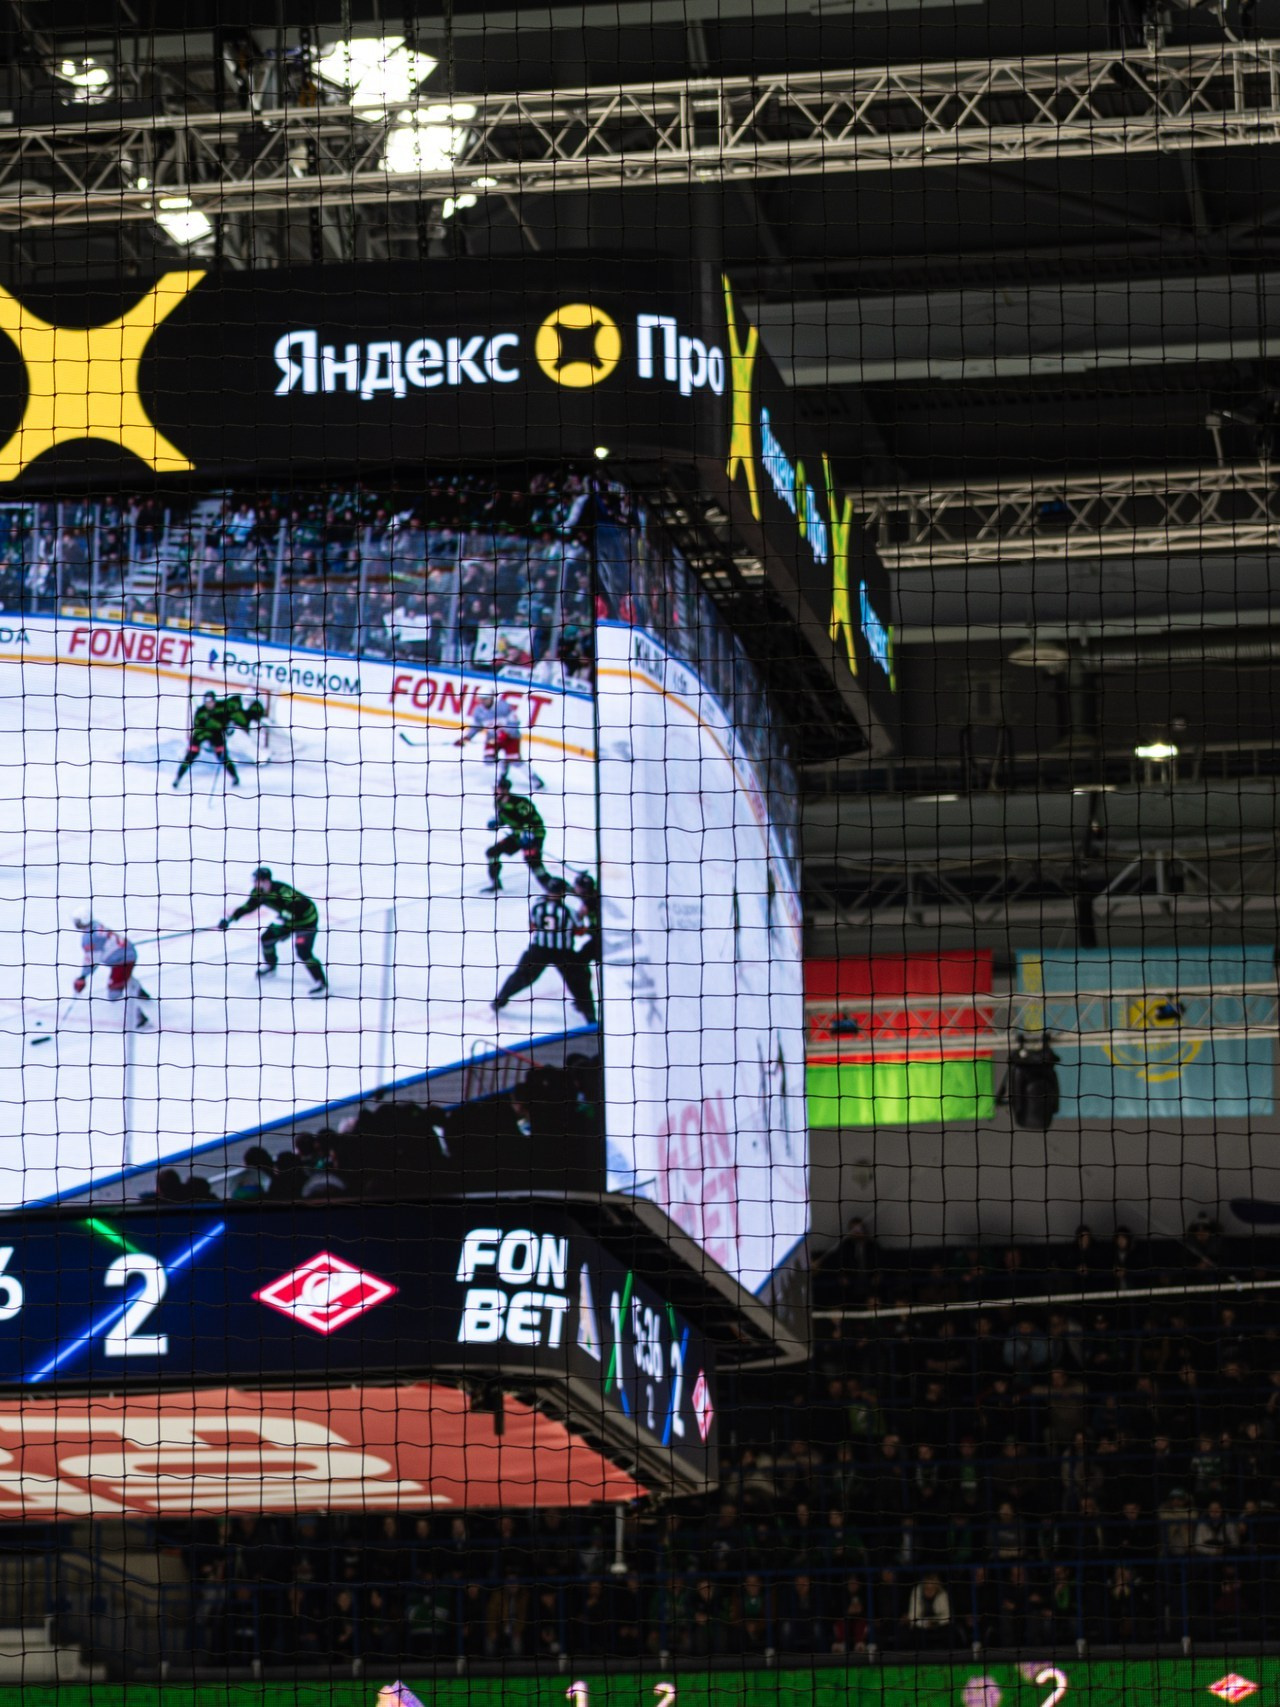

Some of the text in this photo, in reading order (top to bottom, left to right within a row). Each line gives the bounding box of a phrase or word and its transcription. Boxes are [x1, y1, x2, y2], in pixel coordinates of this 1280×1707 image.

[274, 313, 724, 400] Яндекс Про
[68, 627, 195, 668] FONBET
[223, 652, 361, 693] Ростелеком
[456, 1228, 568, 1289] FON
[103, 1252, 169, 1358] 2
[457, 1288, 570, 1349] BET
[610, 1291, 623, 1390] 1
[671, 1340, 685, 1438] 2
